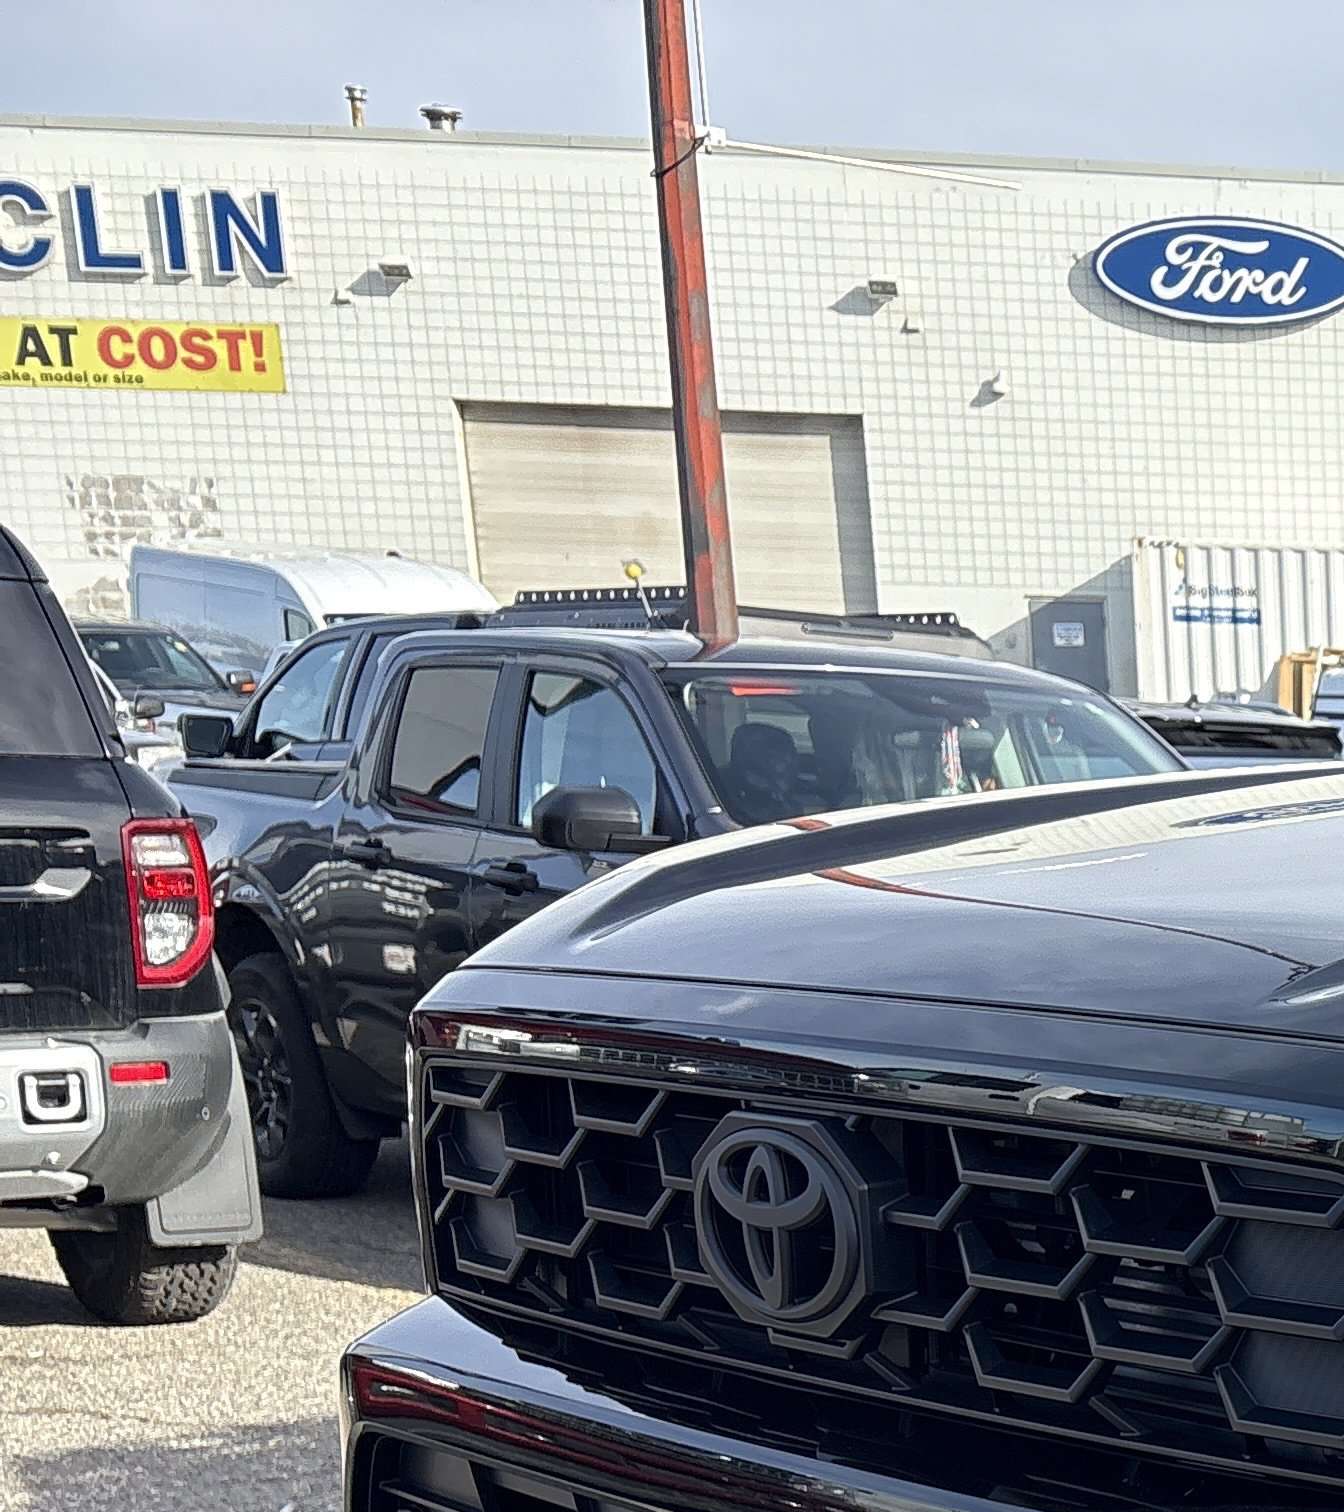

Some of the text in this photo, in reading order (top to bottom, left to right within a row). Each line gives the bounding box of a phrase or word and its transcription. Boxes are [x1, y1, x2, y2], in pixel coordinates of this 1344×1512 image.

[1150, 233, 1310, 306] Ford
[15, 323, 268, 373] AT COST!
[0, 369, 144, 386] ake, model or size
